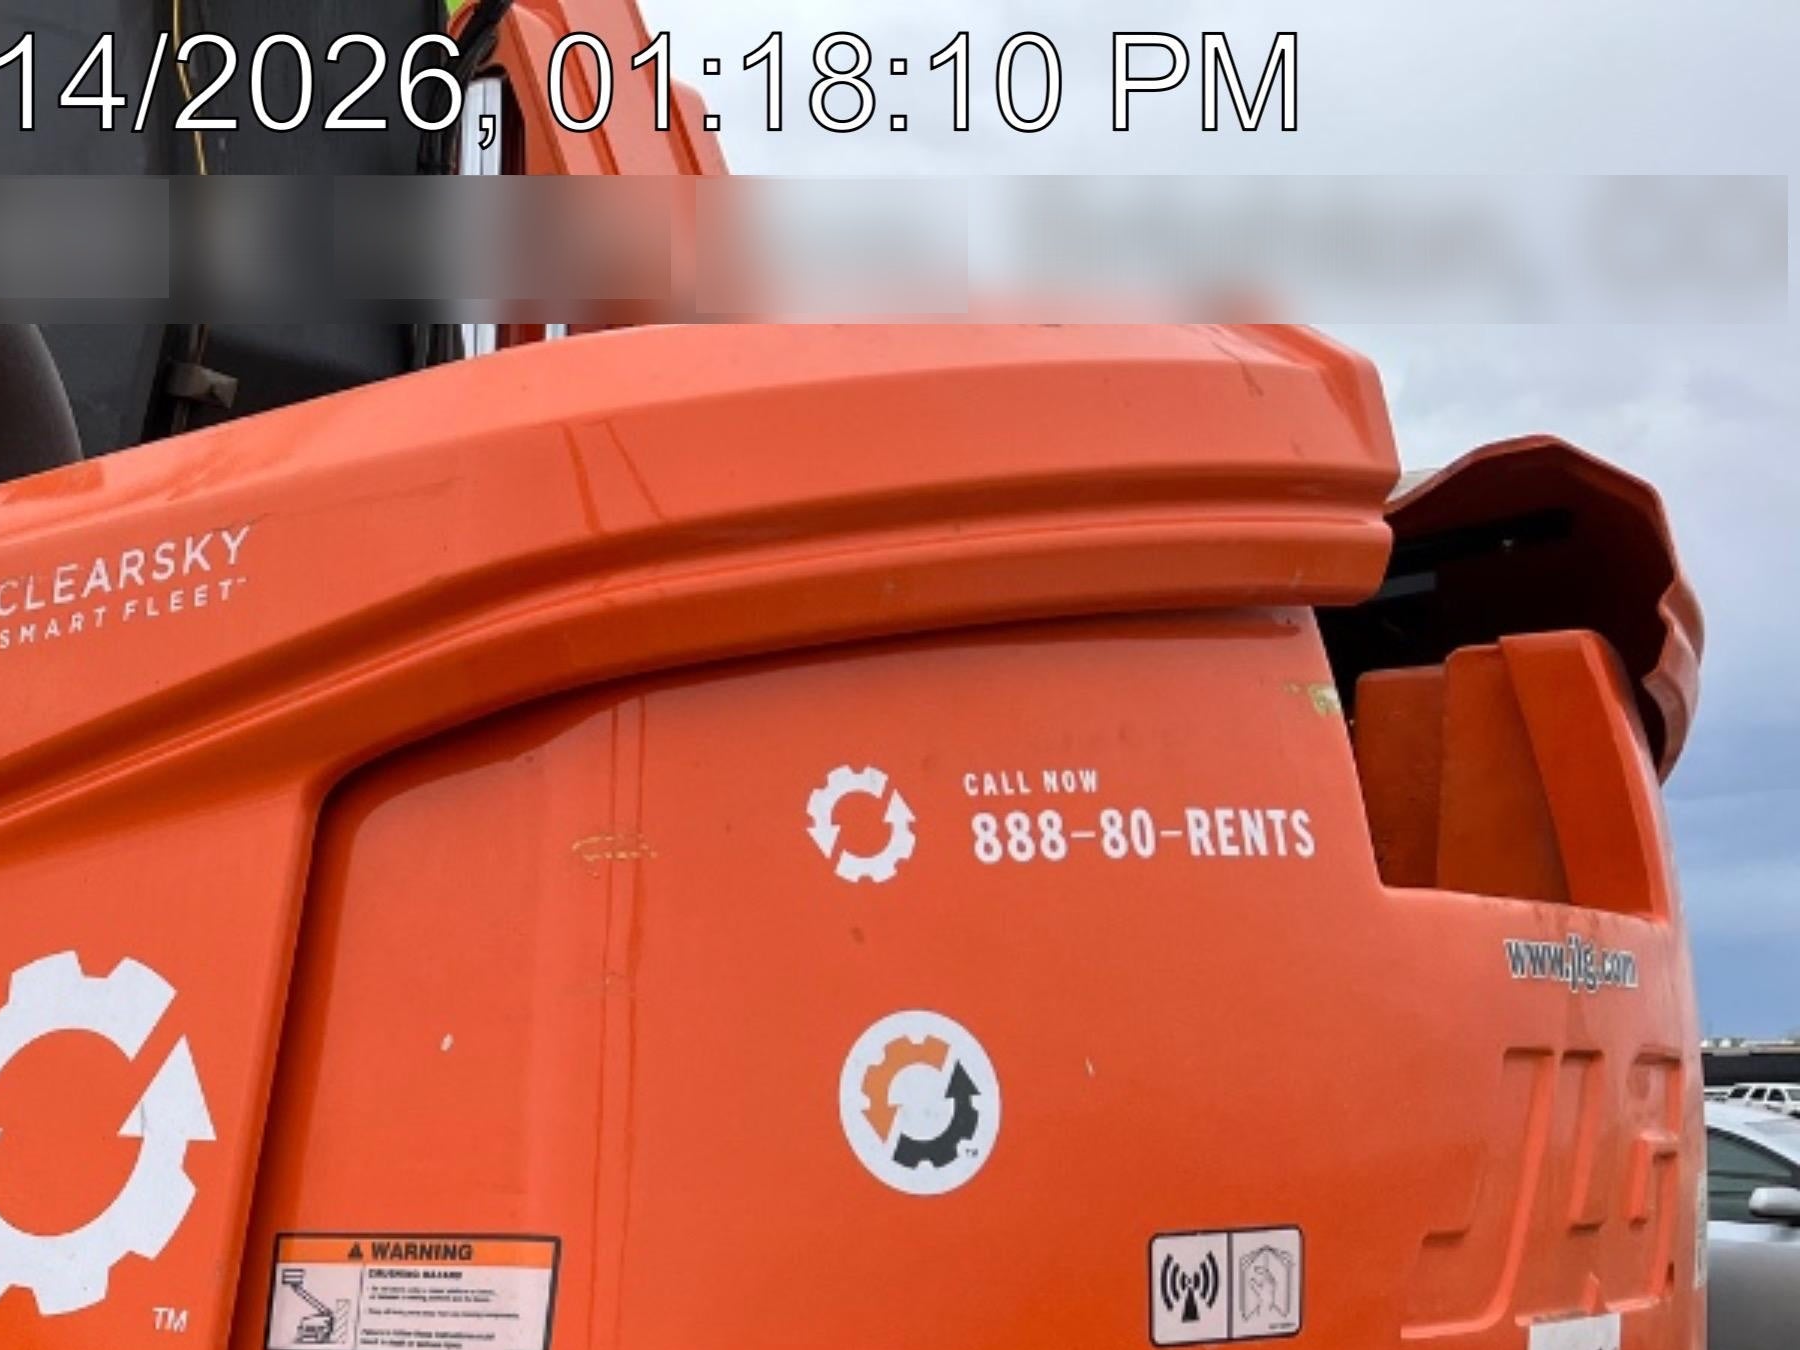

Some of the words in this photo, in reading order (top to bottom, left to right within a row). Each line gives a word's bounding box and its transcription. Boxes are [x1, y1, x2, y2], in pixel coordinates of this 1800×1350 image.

[963, 772, 1031, 796] CALL
[1043, 770, 1098, 793] NOW
[971, 808, 1316, 864] 888-80-RENTS
[1503, 933, 1638, 993] www.jlg.com
[371, 1242, 473, 1261] WARNING
[152, 1307, 188, 1333] TM
